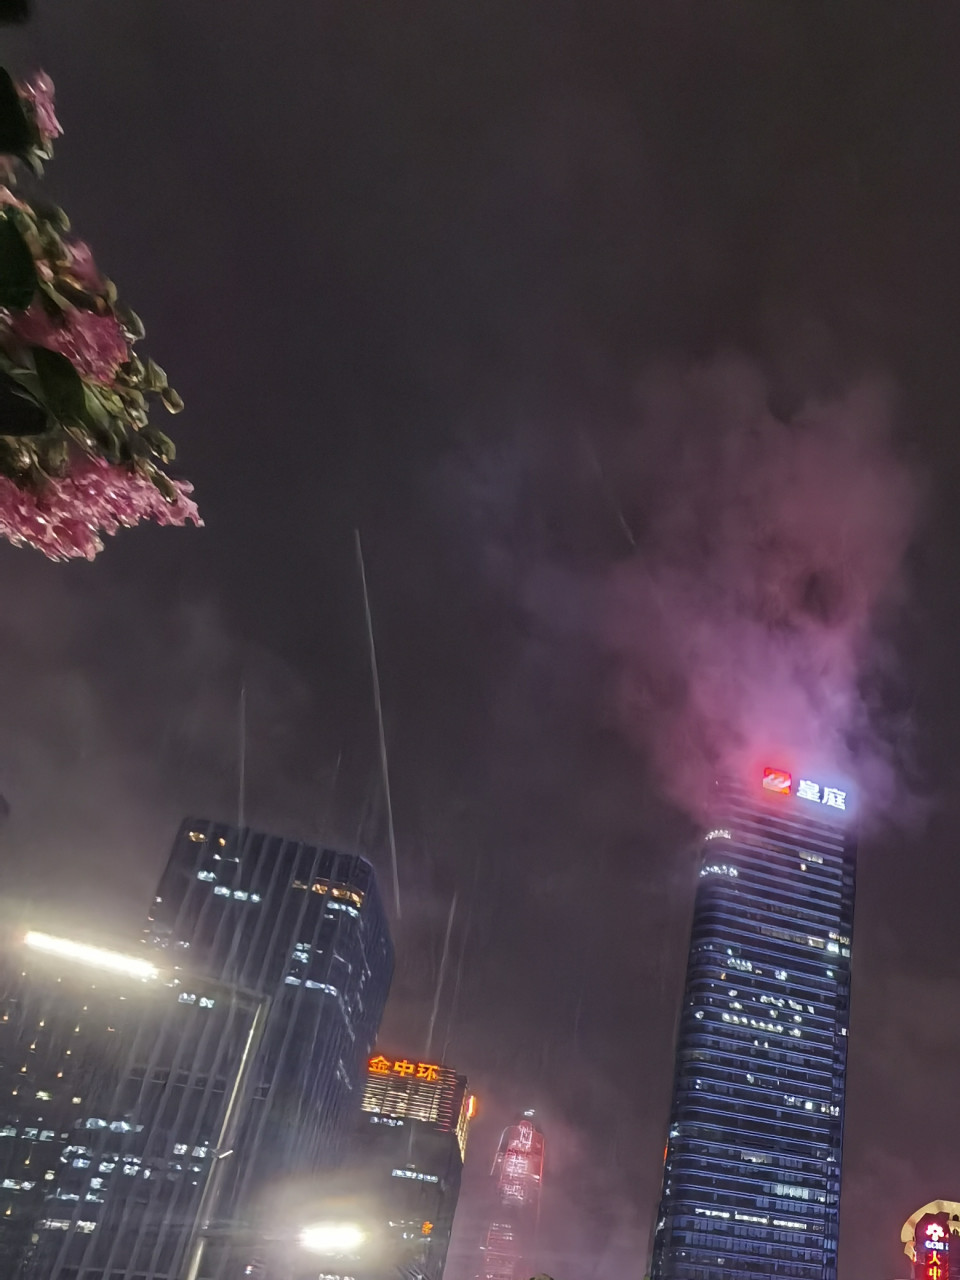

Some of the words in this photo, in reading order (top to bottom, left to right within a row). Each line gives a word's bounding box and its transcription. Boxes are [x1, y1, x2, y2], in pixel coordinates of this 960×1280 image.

[796, 779, 847, 810] 皇庭
[368, 1055, 440, 1081] 金中环
